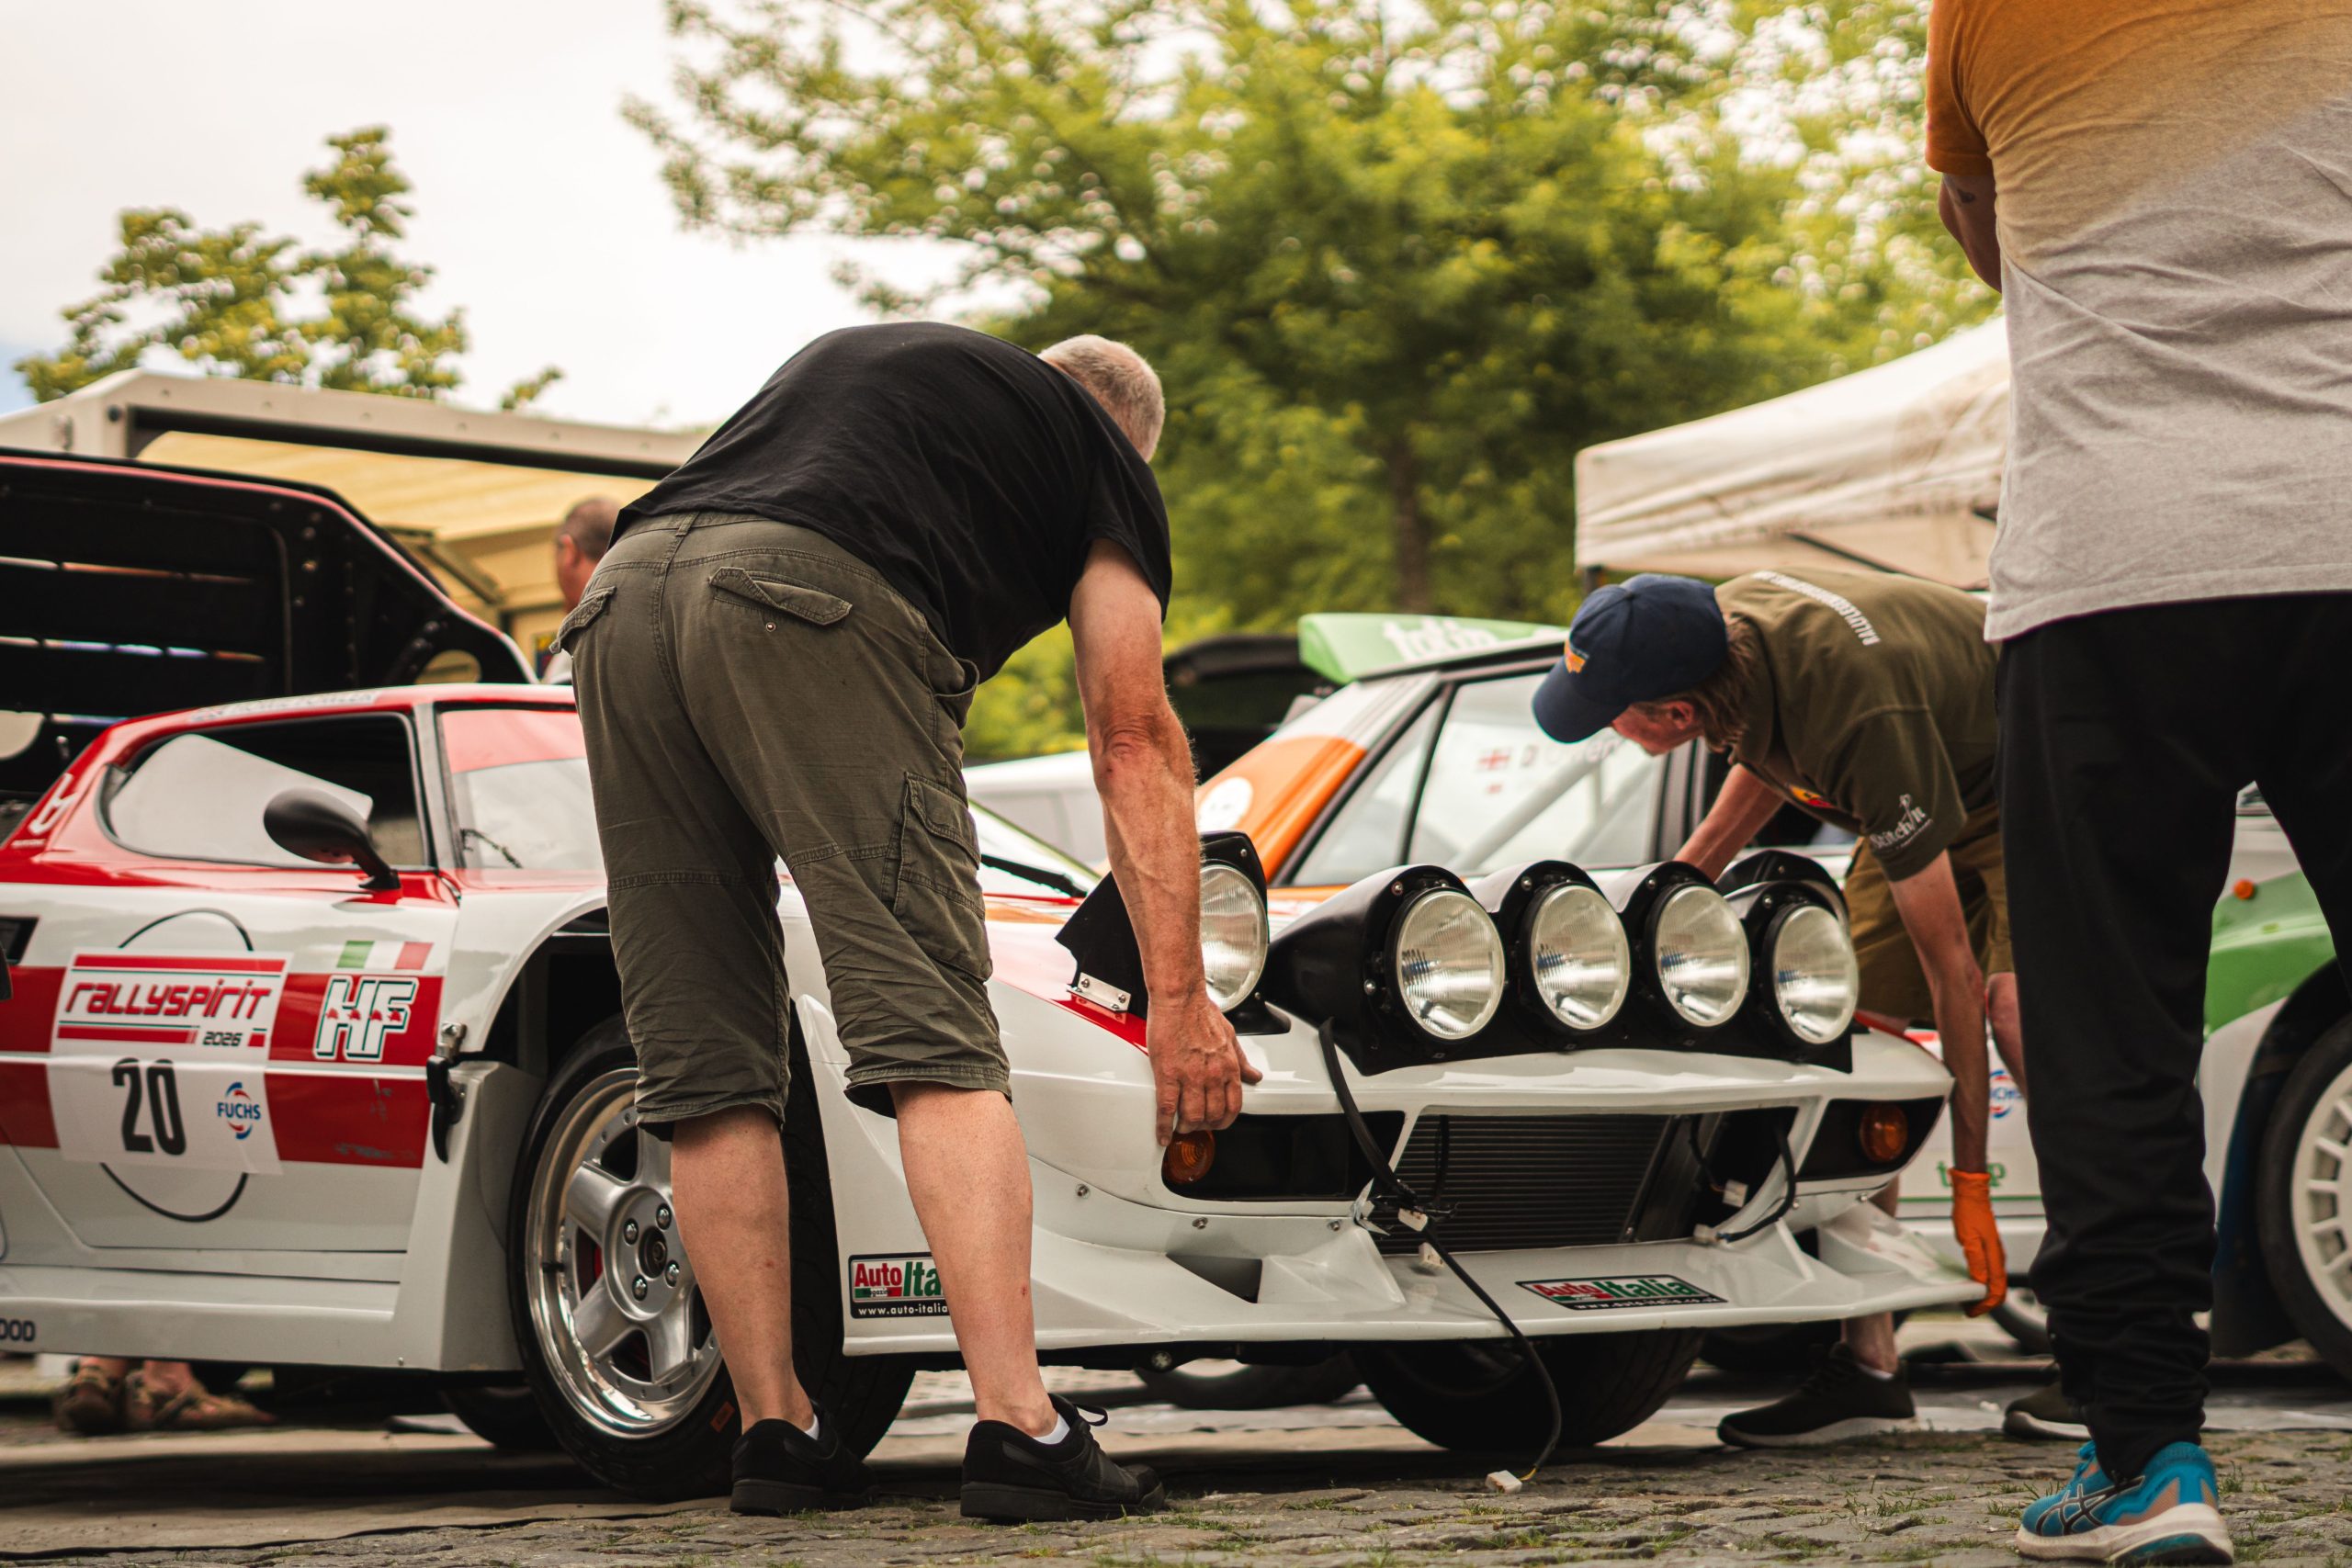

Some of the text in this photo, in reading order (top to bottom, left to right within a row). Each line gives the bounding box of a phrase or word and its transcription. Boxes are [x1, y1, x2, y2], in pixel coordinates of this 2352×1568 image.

[314, 976, 420, 1062] HF
[202, 1031, 243, 1047] 2026
[111, 1057, 187, 1156] 20
[217, 1102, 261, 1120] FUCHS
[903, 1261, 944, 1297] Ita
[1593, 1279, 1700, 1298] Italia
